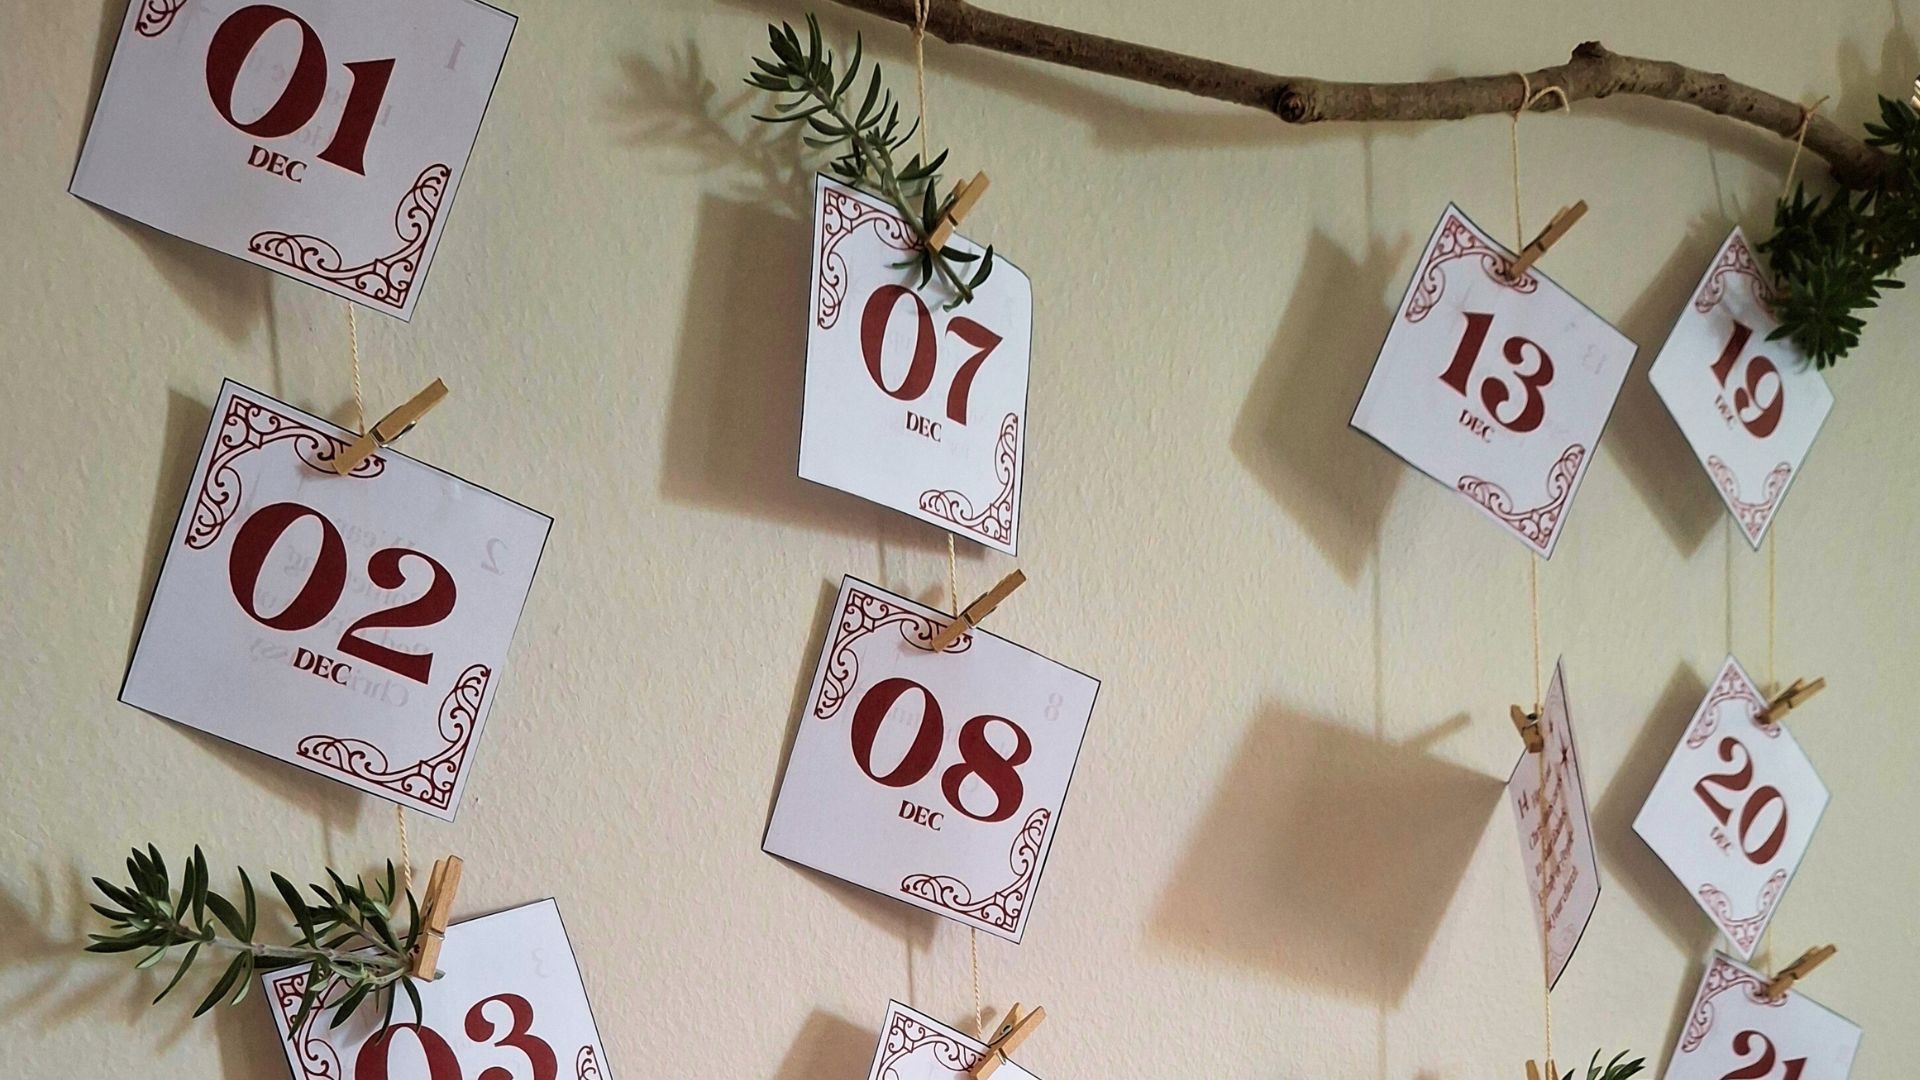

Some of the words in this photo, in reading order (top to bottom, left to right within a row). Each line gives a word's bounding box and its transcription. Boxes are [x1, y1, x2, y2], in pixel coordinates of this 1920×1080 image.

[205, 5, 396, 175] 01
[248, 145, 307, 182] DEC
[860, 284, 1003, 425] 07
[1438, 311, 1554, 433] 13
[1711, 320, 1784, 438] 19
[905, 411, 943, 442] DEC
[1458, 408, 1495, 443] DEC
[228, 502, 457, 684] 02
[293, 646, 353, 686] DEC
[850, 677, 1032, 822] 08
[1693, 736, 1787, 864] 20
[898, 799, 945, 831] DEC
